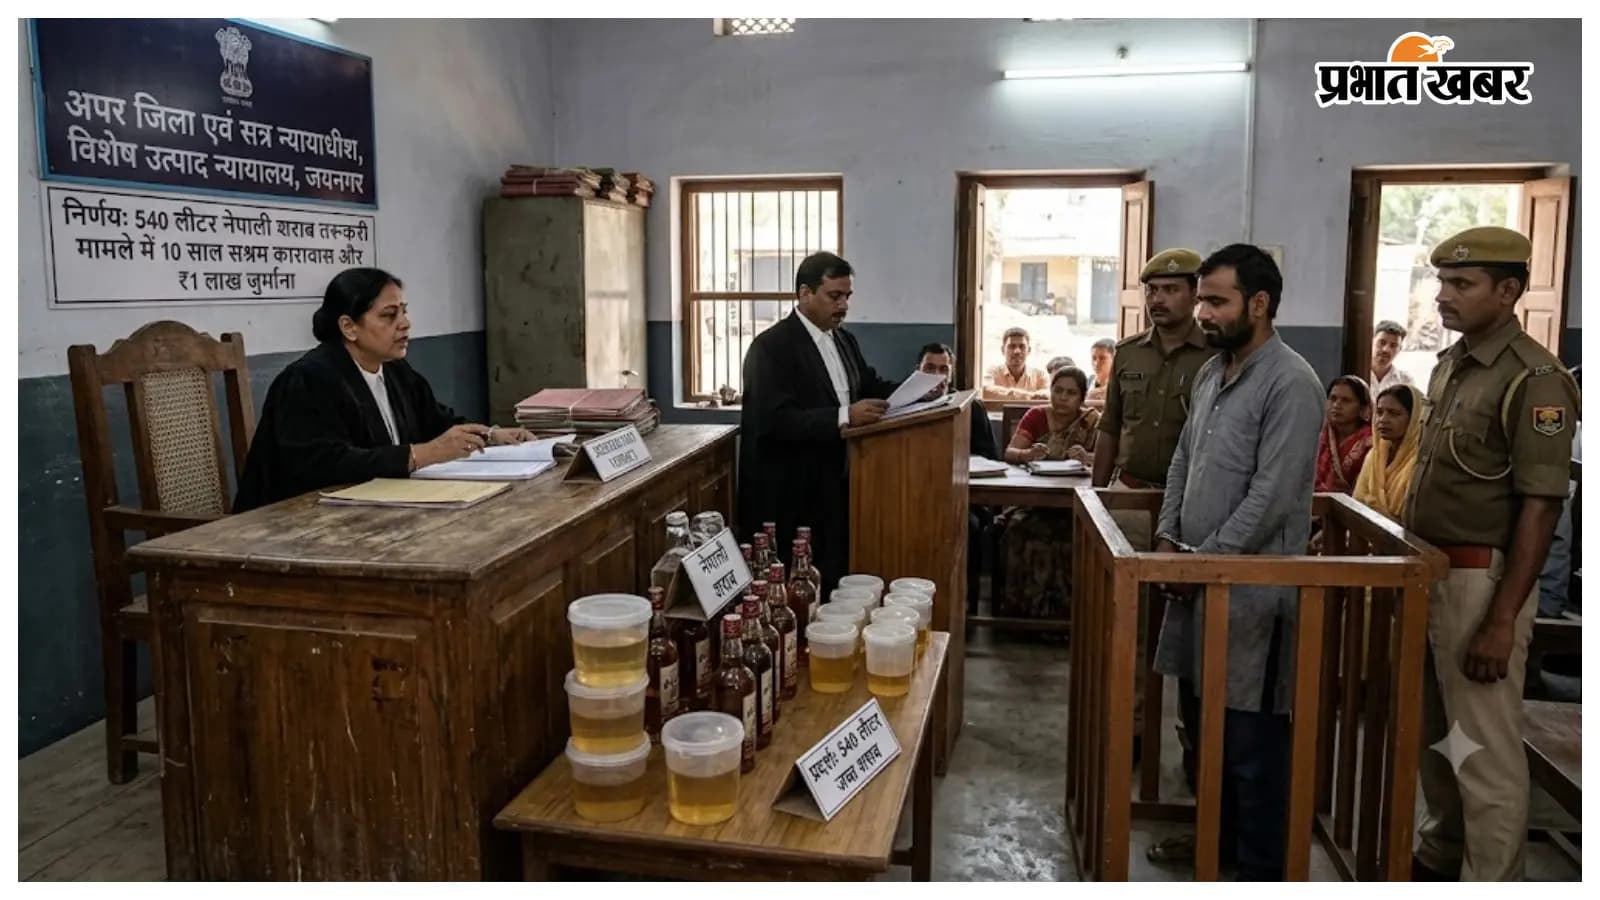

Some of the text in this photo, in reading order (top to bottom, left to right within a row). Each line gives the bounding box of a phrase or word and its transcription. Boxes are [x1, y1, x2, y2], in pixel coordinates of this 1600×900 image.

[64, 89, 364, 166] अपर जिला एवं सत्र न्यायाधीश,
[67, 126, 364, 194] विशेष उत्पाद न्यायालय, जयनगर
[135, 209, 169, 231] 540
[174, 207, 217, 233] लीटर
[222, 209, 272, 236] नेपाली
[276, 219, 315, 239] शराब
[76, 234, 363, 265] मामले में 10 साल सश्रम कारावास और
[178, 267, 296, 296] ₹1 लाख जुर्माना
[837, 732, 859, 758] 540
